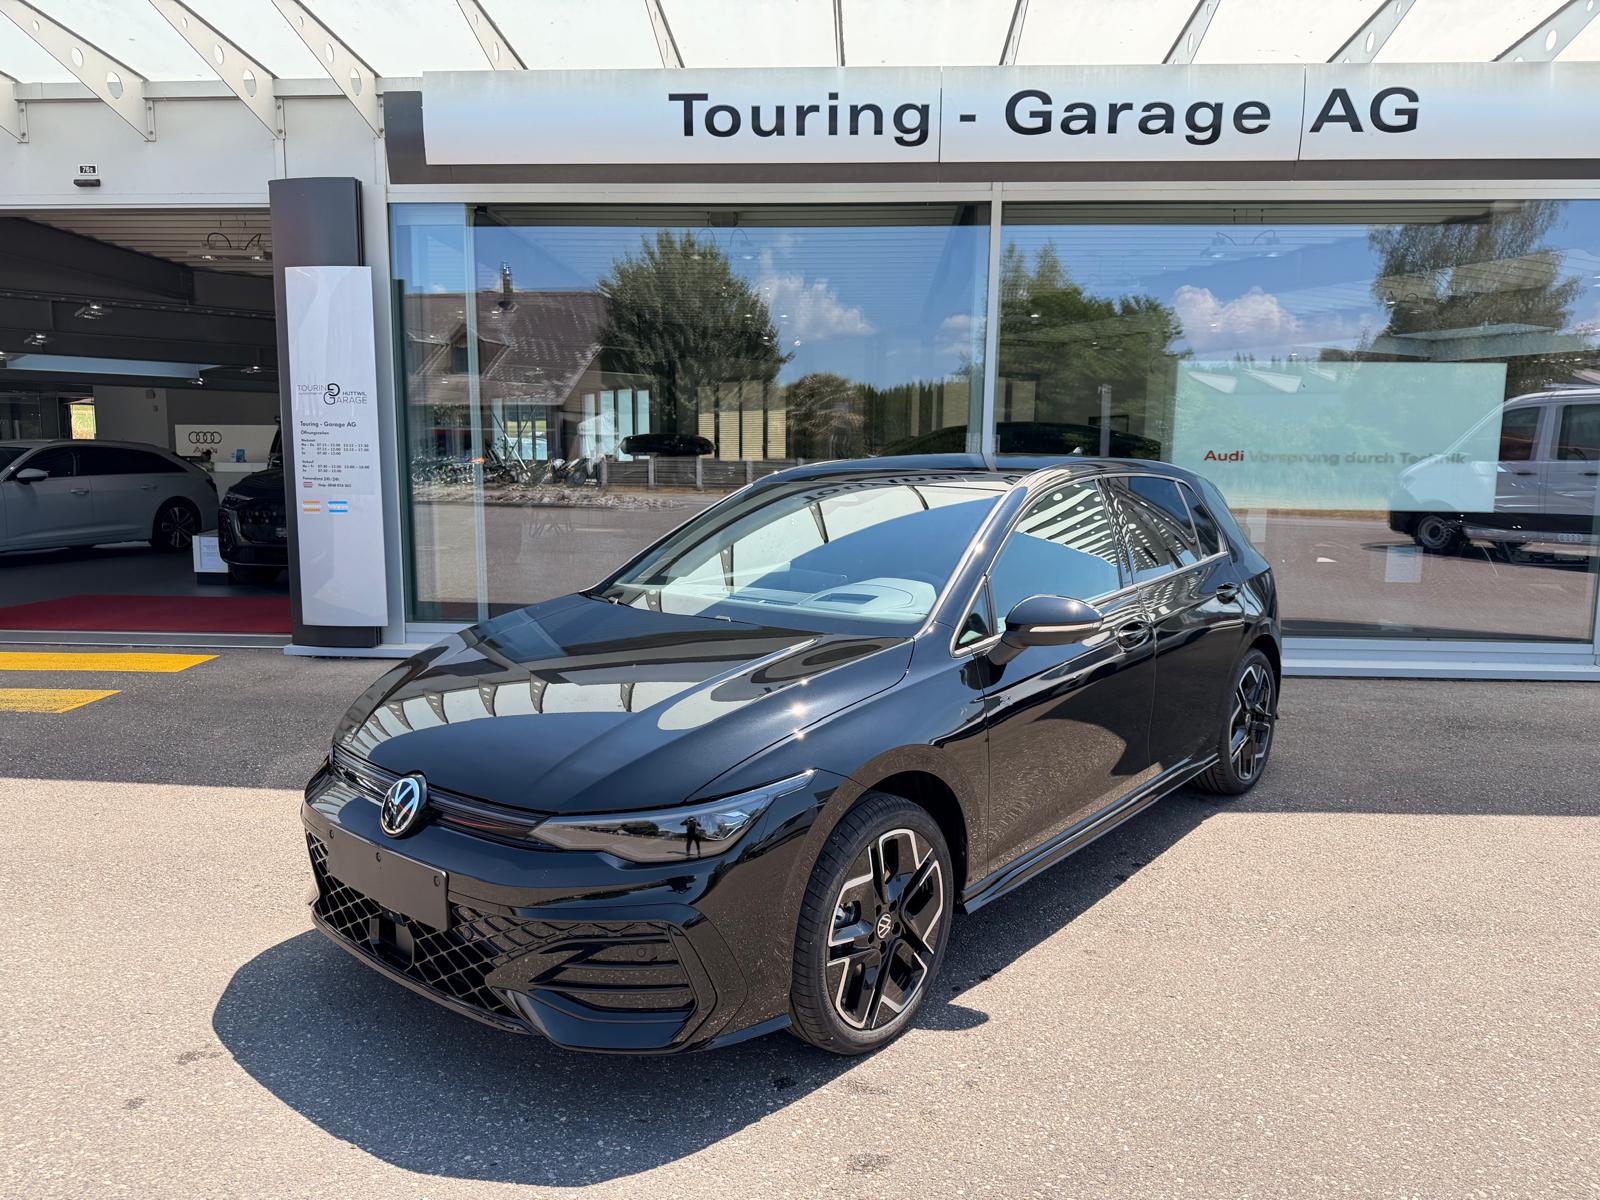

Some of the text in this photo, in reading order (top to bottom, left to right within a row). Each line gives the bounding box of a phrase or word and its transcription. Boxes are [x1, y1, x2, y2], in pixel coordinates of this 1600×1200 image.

[668, 87, 1420, 147] Touring - Garage AG
[323, 391, 367, 405] GARAGE
[1204, 450, 1244, 461] Audi
[1249, 450, 1340, 466] Vorsprung
[1344, 451, 1395, 464] durch
